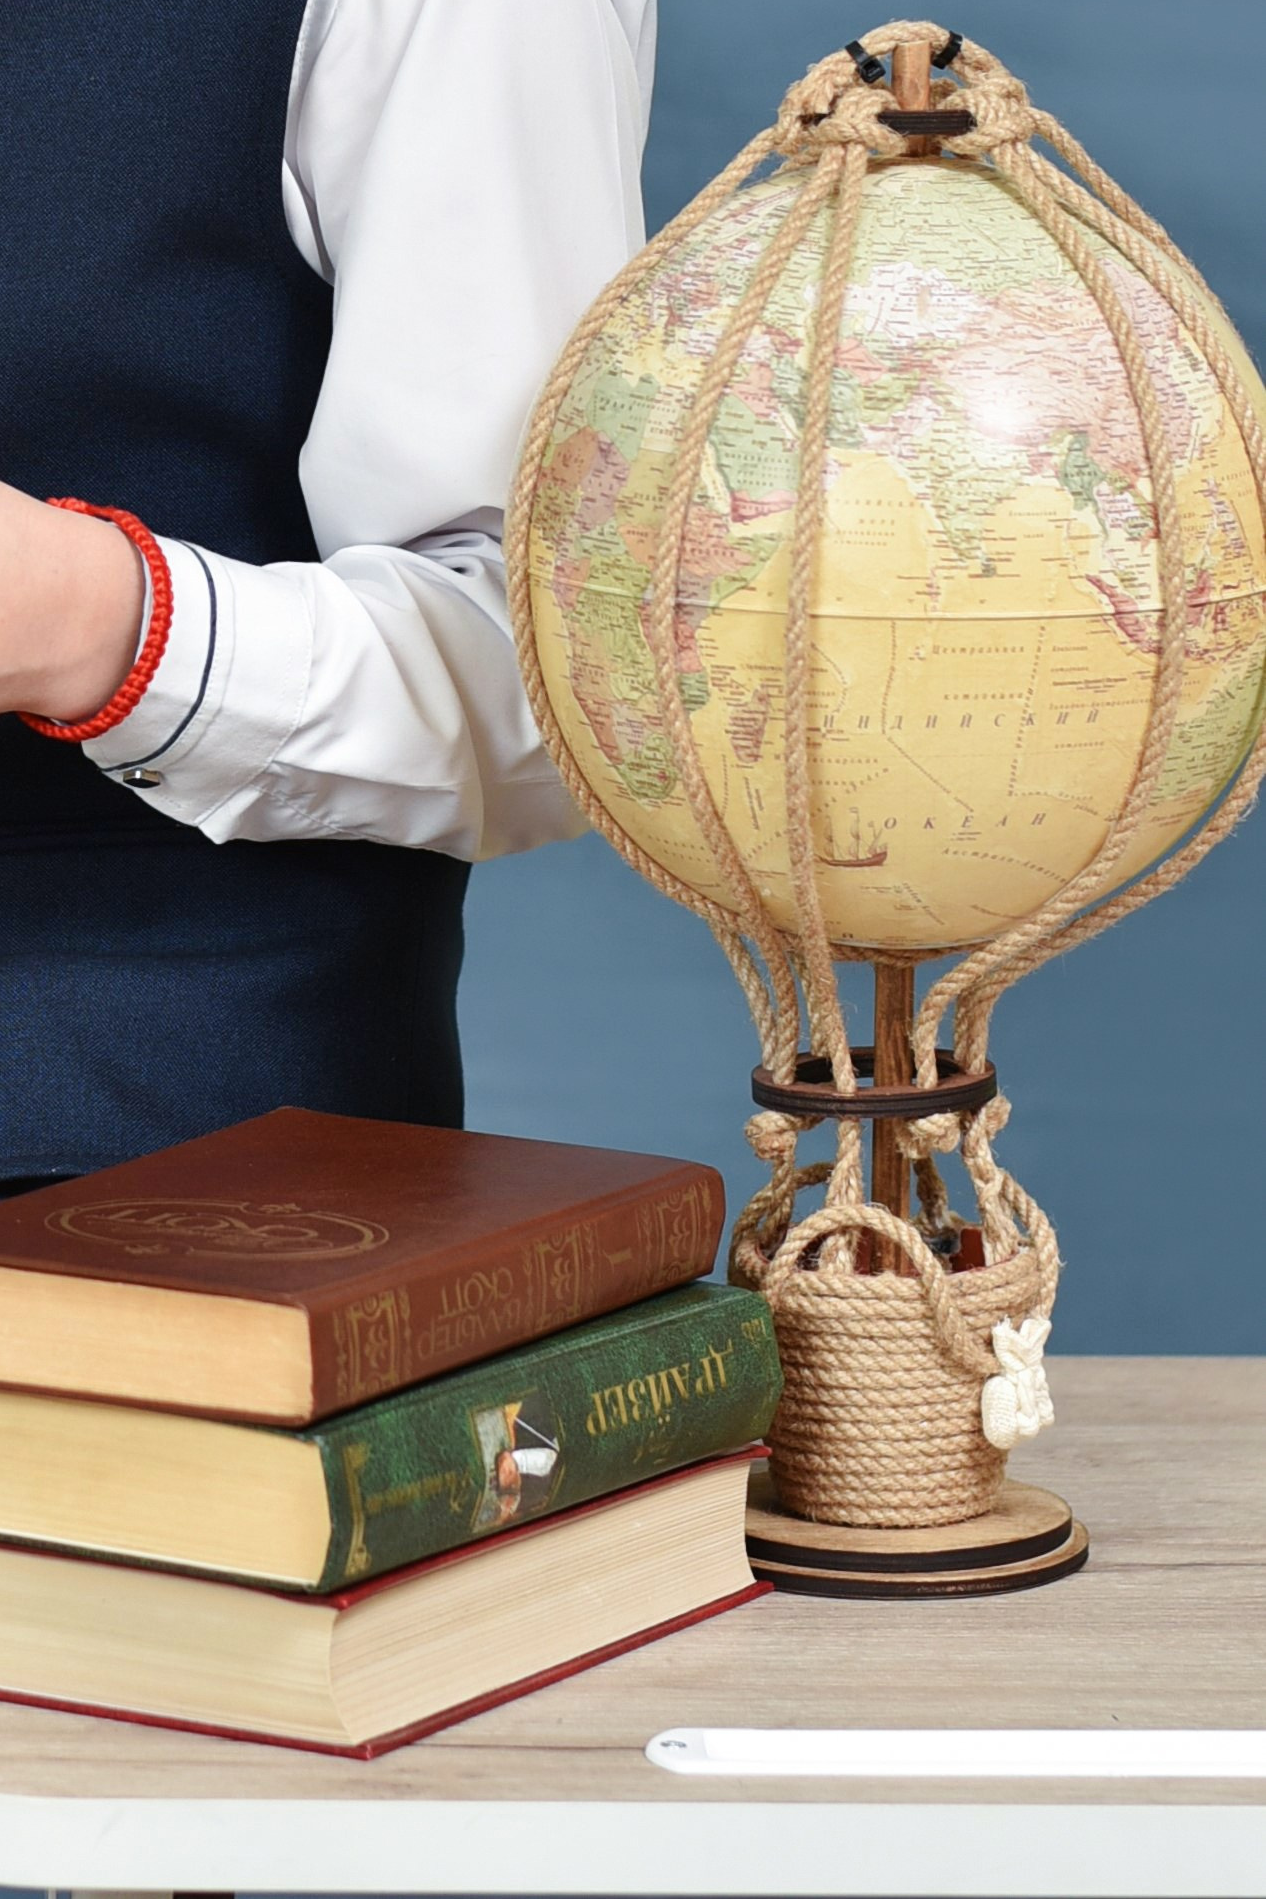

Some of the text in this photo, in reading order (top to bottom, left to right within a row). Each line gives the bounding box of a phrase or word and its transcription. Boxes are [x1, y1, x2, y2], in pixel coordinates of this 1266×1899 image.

[884, 812, 1046, 829] ОКЕАН
[436, 1264, 515, 1320] СКОТТ
[585, 1341, 733, 1437] ДРАЙЗЕР
